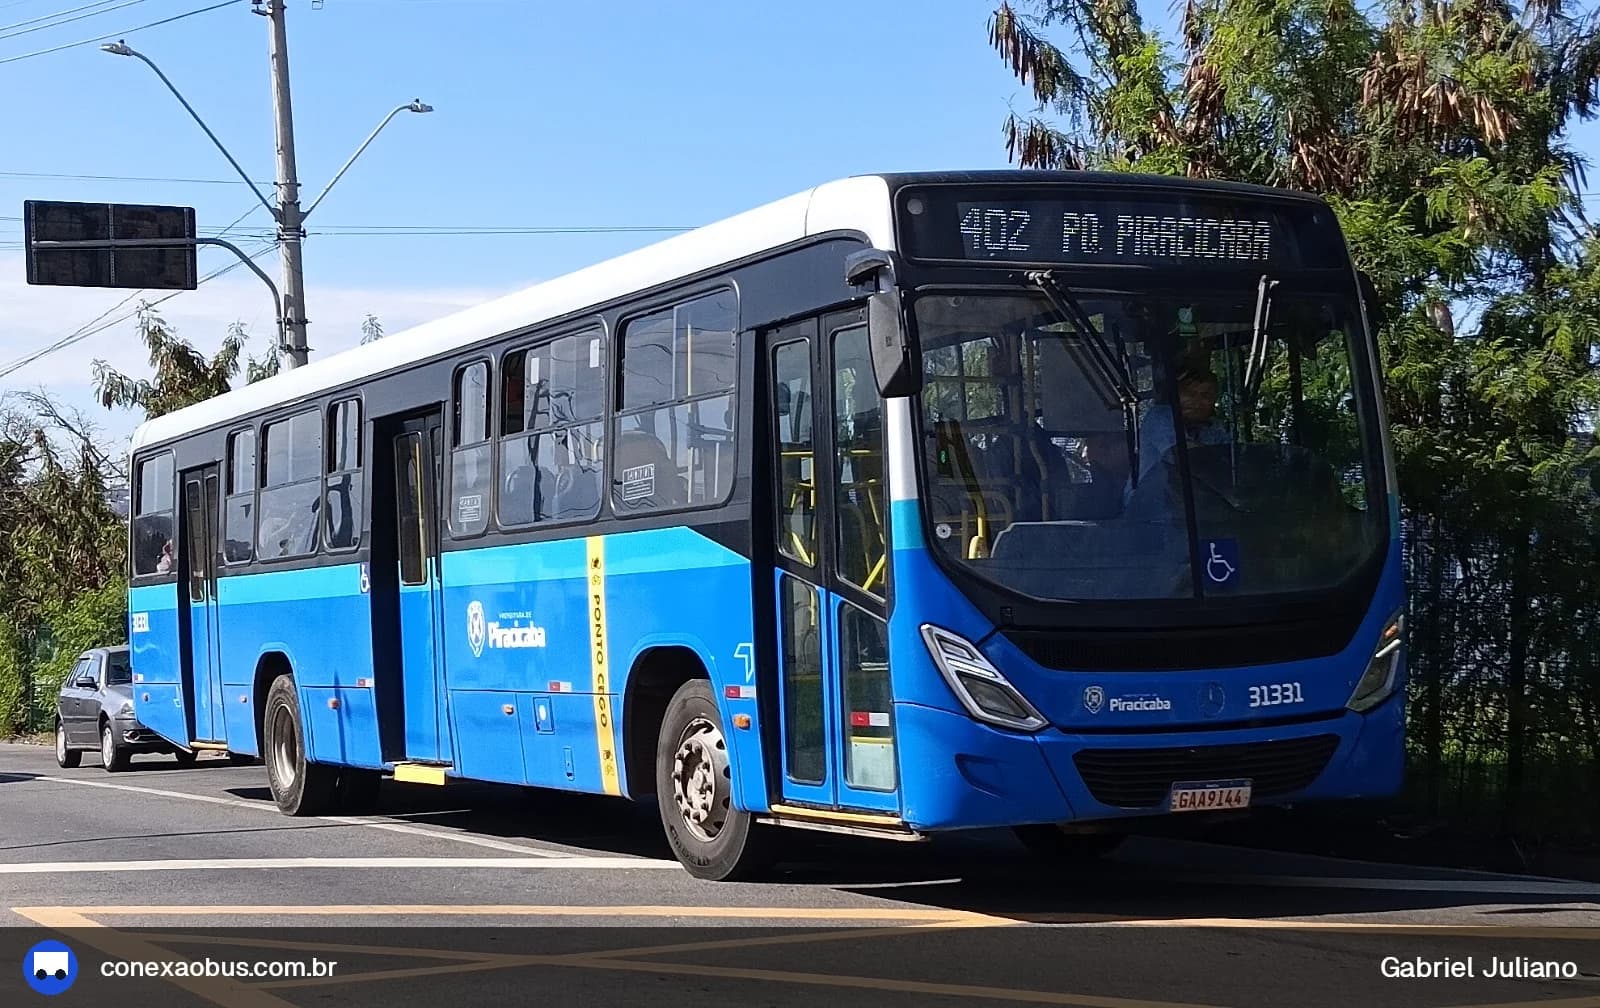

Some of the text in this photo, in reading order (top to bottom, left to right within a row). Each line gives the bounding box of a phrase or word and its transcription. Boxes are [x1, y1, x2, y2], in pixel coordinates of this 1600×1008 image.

[959, 207, 1031, 252] 402
[1116, 214, 1271, 260] PIRACICABA
[487, 620, 546, 649] Piracicaba
[593, 594, 608, 728] PONTO CEGO
[1109, 697, 1171, 712] Piracicaba
[1248, 682, 1304, 707] 31331
